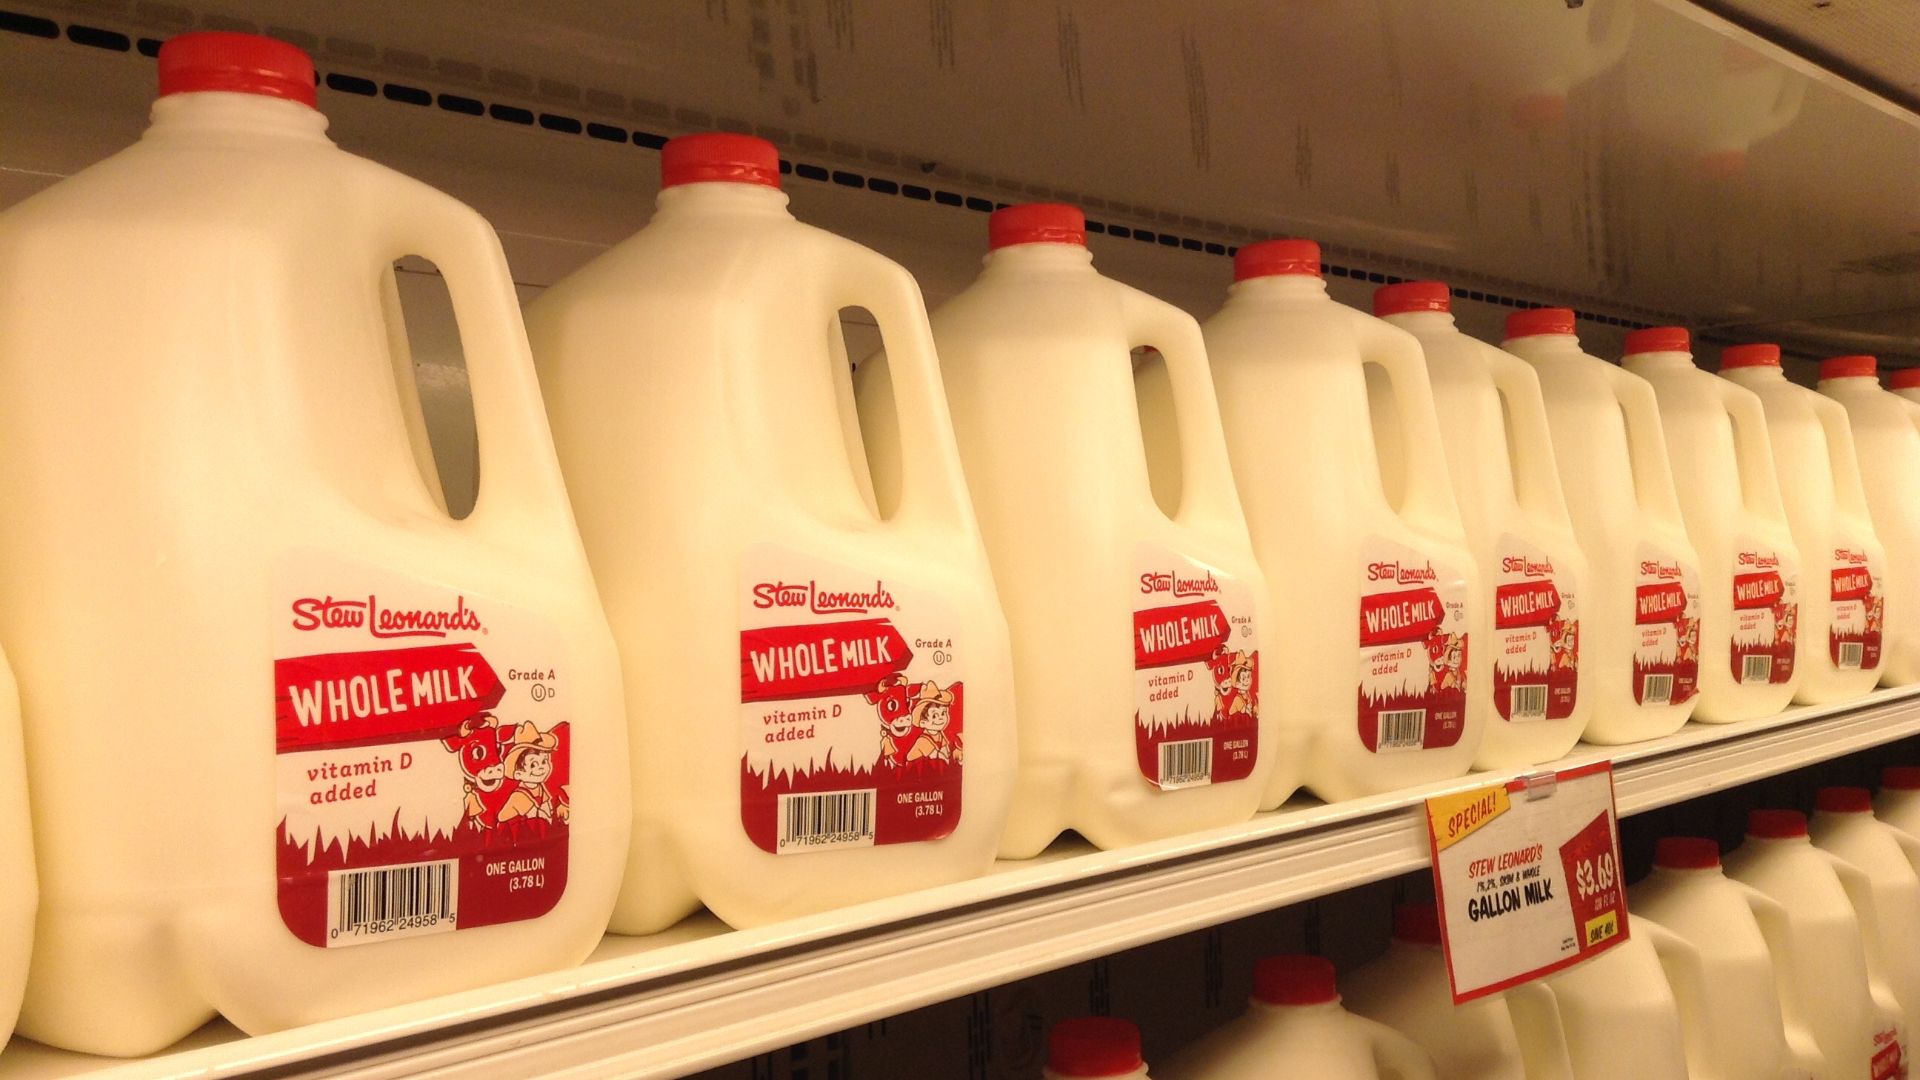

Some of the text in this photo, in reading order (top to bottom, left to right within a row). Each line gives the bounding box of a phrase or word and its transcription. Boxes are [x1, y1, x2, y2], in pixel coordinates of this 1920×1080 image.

[1141, 570, 1219, 597] Stew Leonard's
[1368, 560, 1437, 585] Stew Leonard's
[1834, 574, 1855, 592] WHOLE
[753, 580, 895, 614] Stew Leonard's
[1737, 580, 1764, 601] WHOLE
[1501, 590, 1554, 618] WHOLE MILK
[1640, 591, 1682, 615] WHOLE MILK
[293, 595, 480, 638] Stew Leonard's
[1366, 601, 1411, 633] WHOLE
[1411, 600, 1436, 623] MILK
[915, 638, 952, 649] Grade A
[1140, 614, 1220, 654] WHOLE MILK
[750, 636, 892, 684] WHOLE MILK
[1372, 648, 1412, 663] vitamin D
[508, 670, 556, 681] Grade A
[1149, 669, 1194, 688] vitamin D
[1372, 662, 1399, 676] added
[289, 665, 477, 728] WHOLE MILK
[548, 688, 556, 699] D
[1150, 687, 1179, 703] added
[763, 704, 842, 726] vitamin D
[765, 725, 815, 743] added
[307, 752, 412, 782] vitamin D
[310, 779, 377, 804] added
[897, 791, 943, 804] ONE GALLON
[915, 804, 943, 818] (3.78 L)
[1448, 792, 1497, 838] SPECIAL!
[796, 835, 827, 847] 71962
[830, 831, 860, 843] 24958
[486, 857, 545, 876] ONE GALLON
[1469, 843, 1543, 879] STEW LEONARD'S
[509, 875, 545, 893] (3.78 L)
[1576, 852, 1613, 901] $3.69
[1468, 877, 1553, 922] GALLON MILK
[331, 912, 456, 939] 0 71962 24958 5
